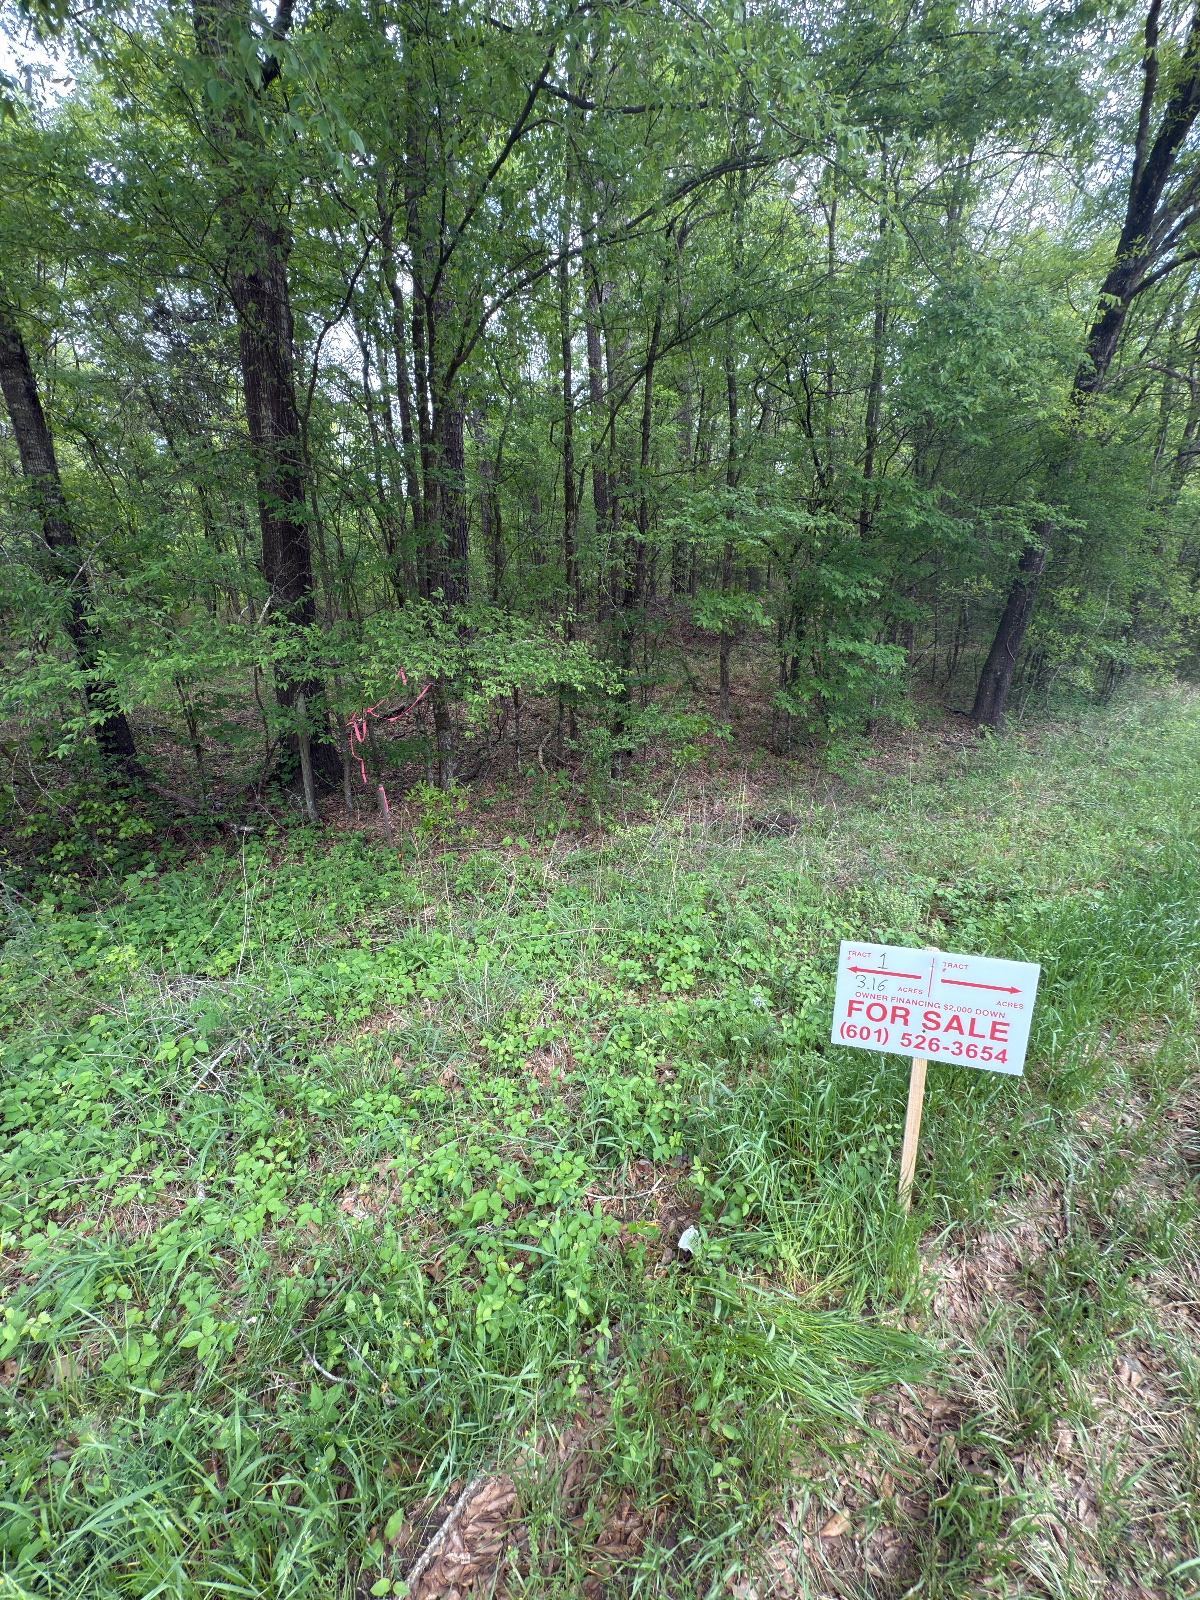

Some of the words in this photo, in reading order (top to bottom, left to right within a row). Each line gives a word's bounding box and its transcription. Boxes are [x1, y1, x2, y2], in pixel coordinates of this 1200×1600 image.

[848, 950, 871, 958] TRACT
[877, 952, 888, 969] 1
[942, 961, 969, 970] TRACT
[855, 974, 888, 991] 3.16
[897, 986, 923, 995] ACRES
[855, 991, 888, 1002] OWNER
[890, 996, 941, 1009] FINANCING
[943, 1003, 972, 1014] $2,000
[975, 1008, 1006, 1019] DOWN
[996, 1000, 1024, 1010] ACRES
[846, 999, 910, 1026] FOR
[921, 1010, 1010, 1042] SALE
[839, 1021, 889, 1046] (601)
[899, 1032, 1008, 1064] 526-3654
